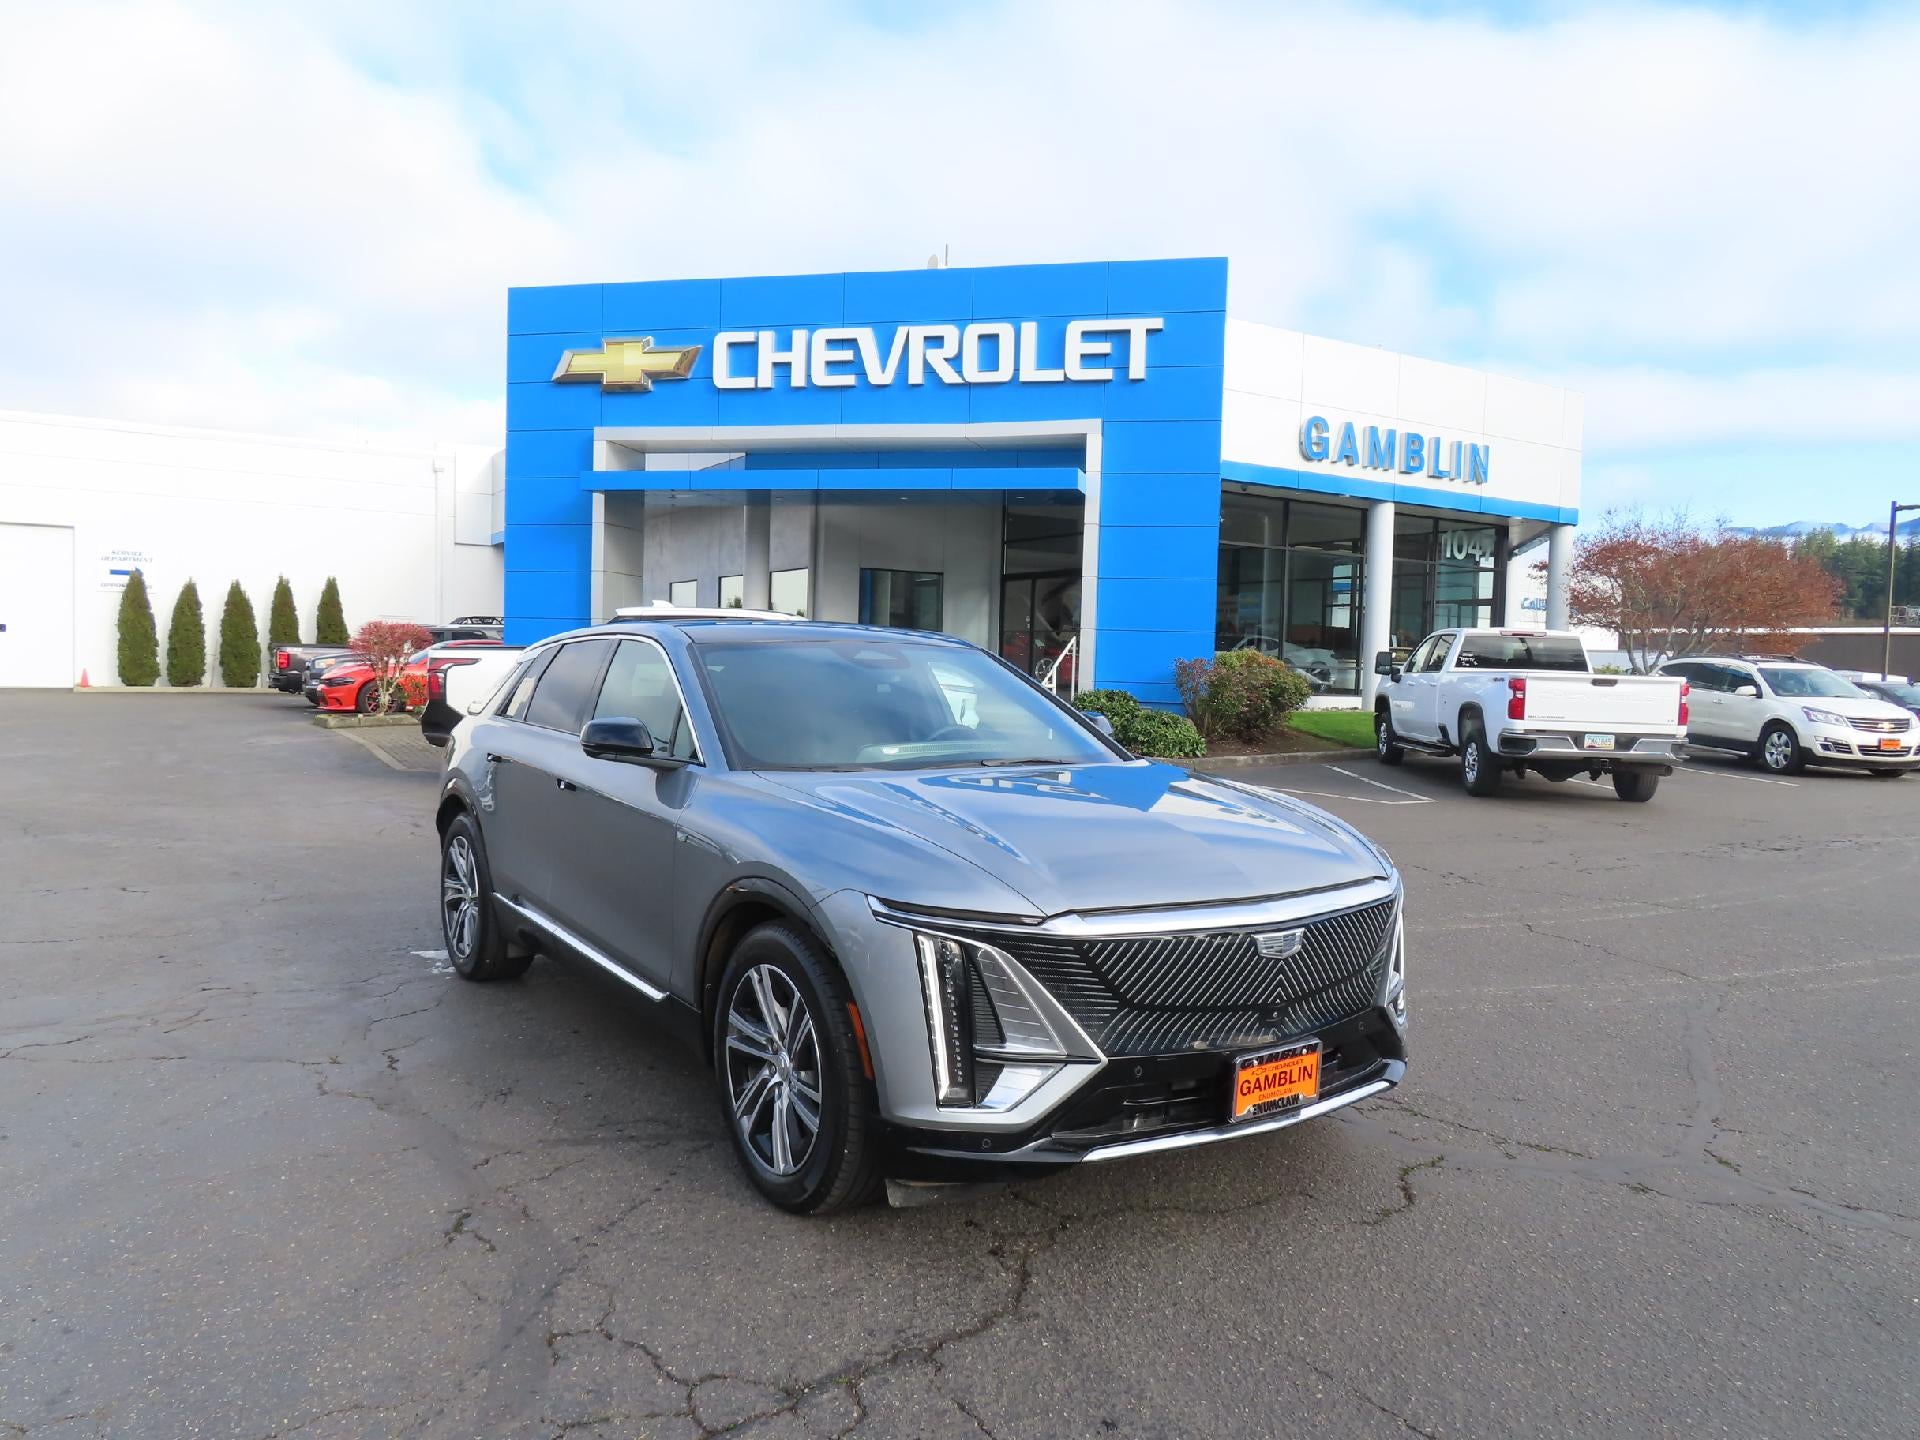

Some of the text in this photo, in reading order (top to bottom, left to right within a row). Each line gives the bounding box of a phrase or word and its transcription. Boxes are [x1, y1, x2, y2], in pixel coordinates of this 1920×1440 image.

[713, 318, 1164, 389] CHEVROLET
[1299, 415, 1490, 485] GAMBLIN
[1240, 1064, 1314, 1096] GAMBLIN
[1252, 1093, 1300, 1116] ENUMCLAW
